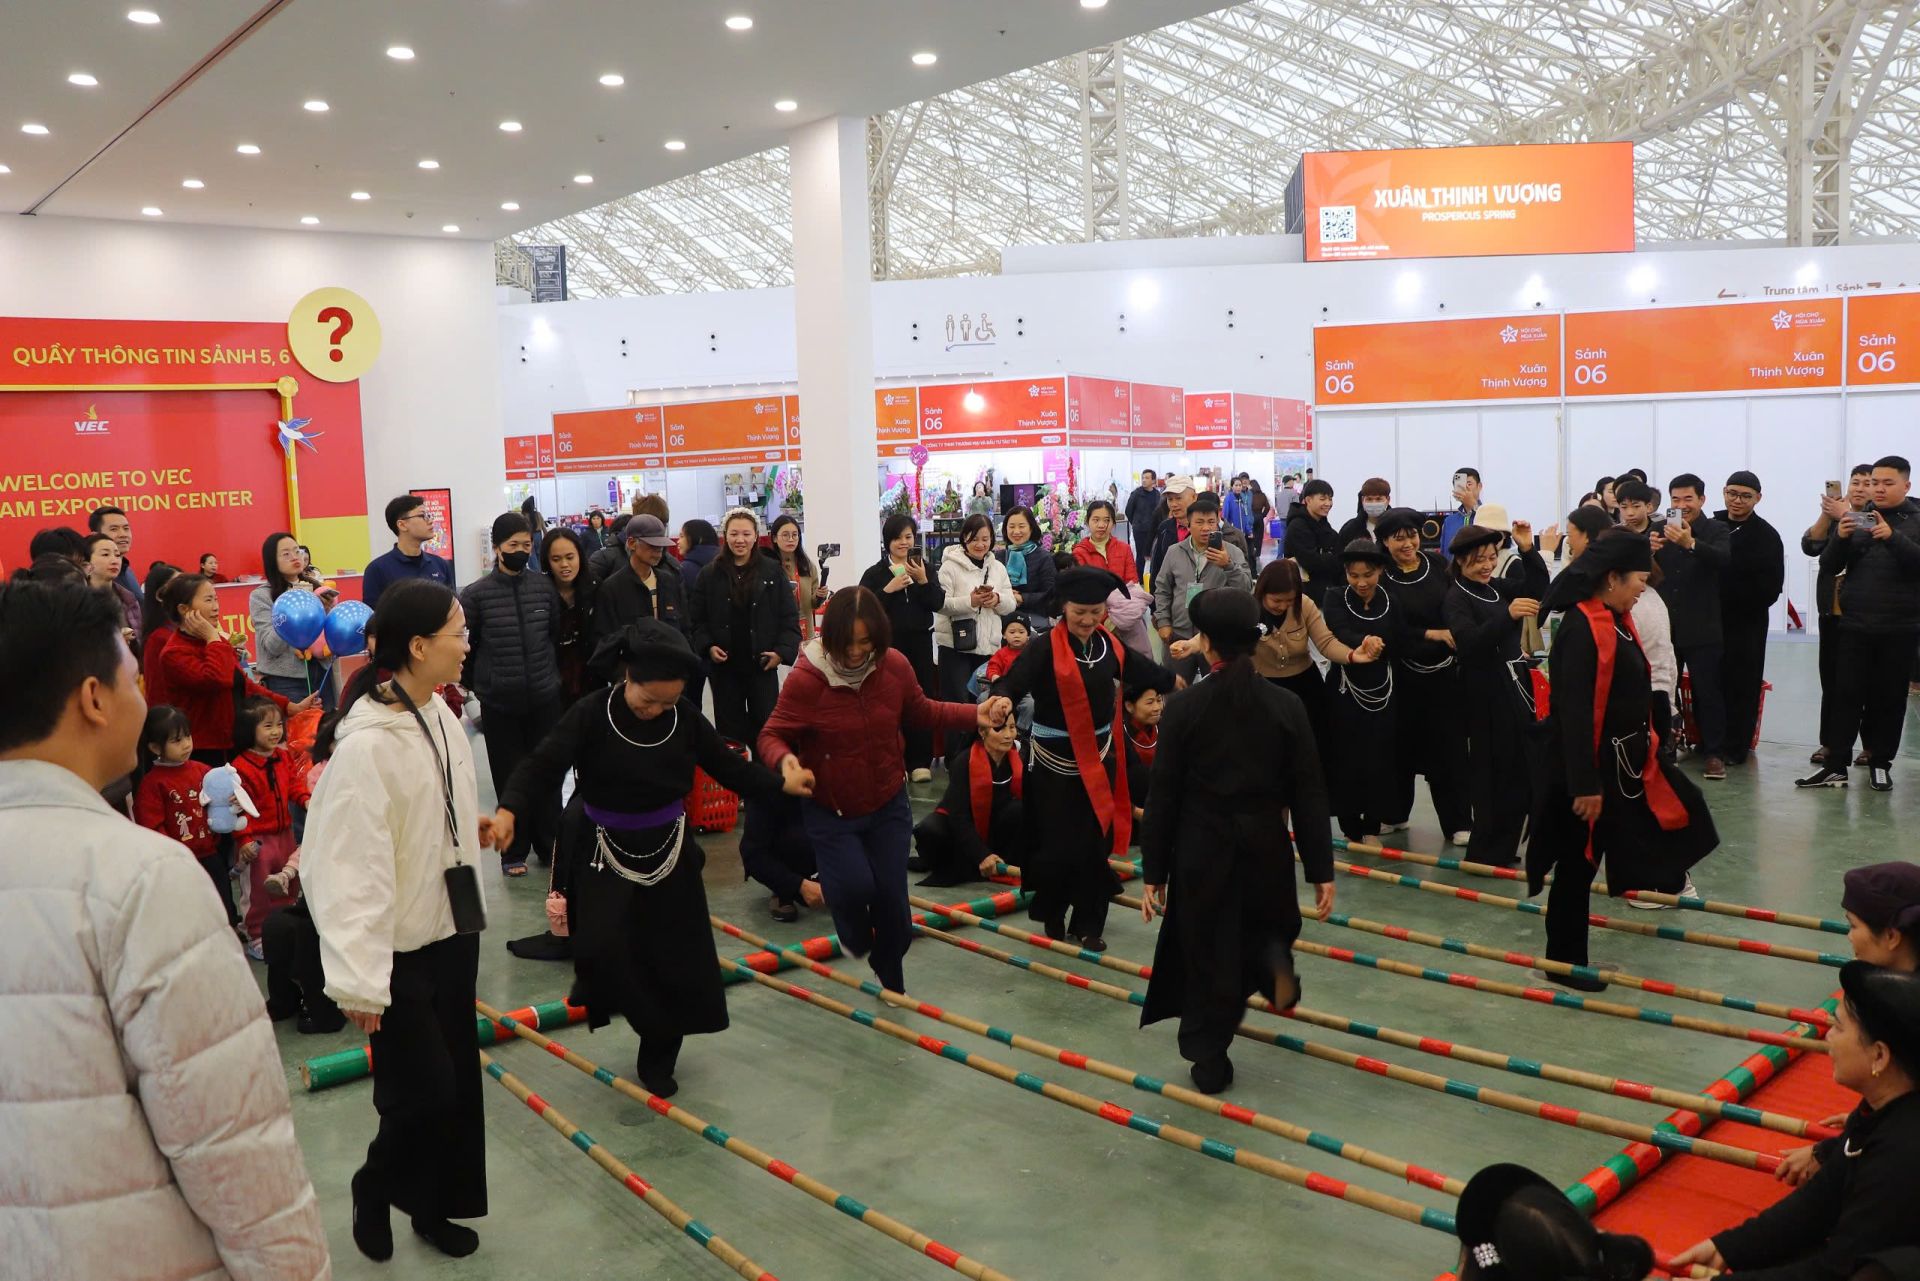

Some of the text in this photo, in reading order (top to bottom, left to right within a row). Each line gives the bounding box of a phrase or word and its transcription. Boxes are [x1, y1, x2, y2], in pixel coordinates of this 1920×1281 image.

[1374, 183, 1561, 208] XUÂN THỊNH VƯỢNG
[1422, 209, 1516, 222] PROSPEROUS SPRING
[1797, 286, 1819, 295] tâm
[1859, 334, 1896, 346] Sảnh
[13, 342, 291, 367] QUẦY THÔNG TIN SẢNH 5, 6
[1575, 348, 1607, 360] Sảnh
[1793, 352, 1824, 362] Xuân
[1325, 359, 1354, 371] Sảnh
[1858, 351, 1896, 373] 06
[1520, 364, 1547, 374] Xuân
[1574, 364, 1607, 385] 06
[1750, 366, 1825, 380] Thịnh Vượng
[1325, 374, 1354, 394] 06
[1481, 377, 1547, 390] Thịnh Vượng
[924, 407, 942, 415] Sảnh
[1070, 409, 1079, 422] 06
[791, 415, 800, 423] Sả
[924, 417, 942, 431] 06
[1017, 419, 1057, 428] Thịnh Vượng
[74, 421, 110, 432] VEC
[791, 426, 799, 438] 0
[670, 434, 685, 446] 06
[559, 441, 573, 452] 06
[0, 468, 193, 492] WELCOME TO VEC
[41, 494, 170, 516] EXPOSITION
[176, 490, 253, 509] CENTER
